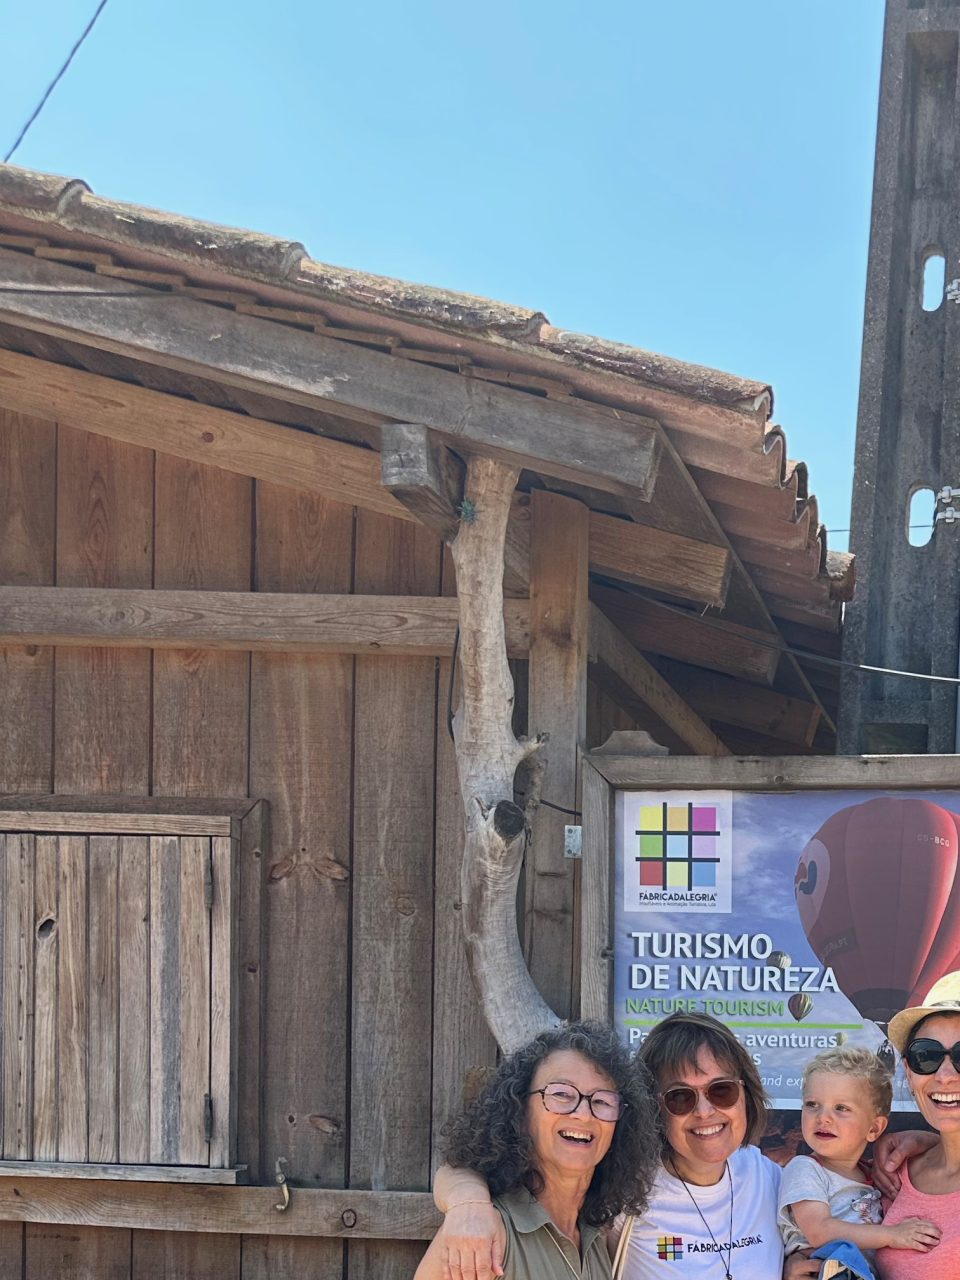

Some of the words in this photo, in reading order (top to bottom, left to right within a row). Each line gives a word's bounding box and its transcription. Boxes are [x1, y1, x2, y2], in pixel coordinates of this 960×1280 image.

[631, 931, 773, 960] TURISMO
[631, 964, 670, 990] DE
[680, 965, 841, 993] NATUREZA
[626, 999, 697, 1015] NATURE
[703, 1000, 785, 1017] TOURISM
[746, 1033, 838, 1049] aventuras
